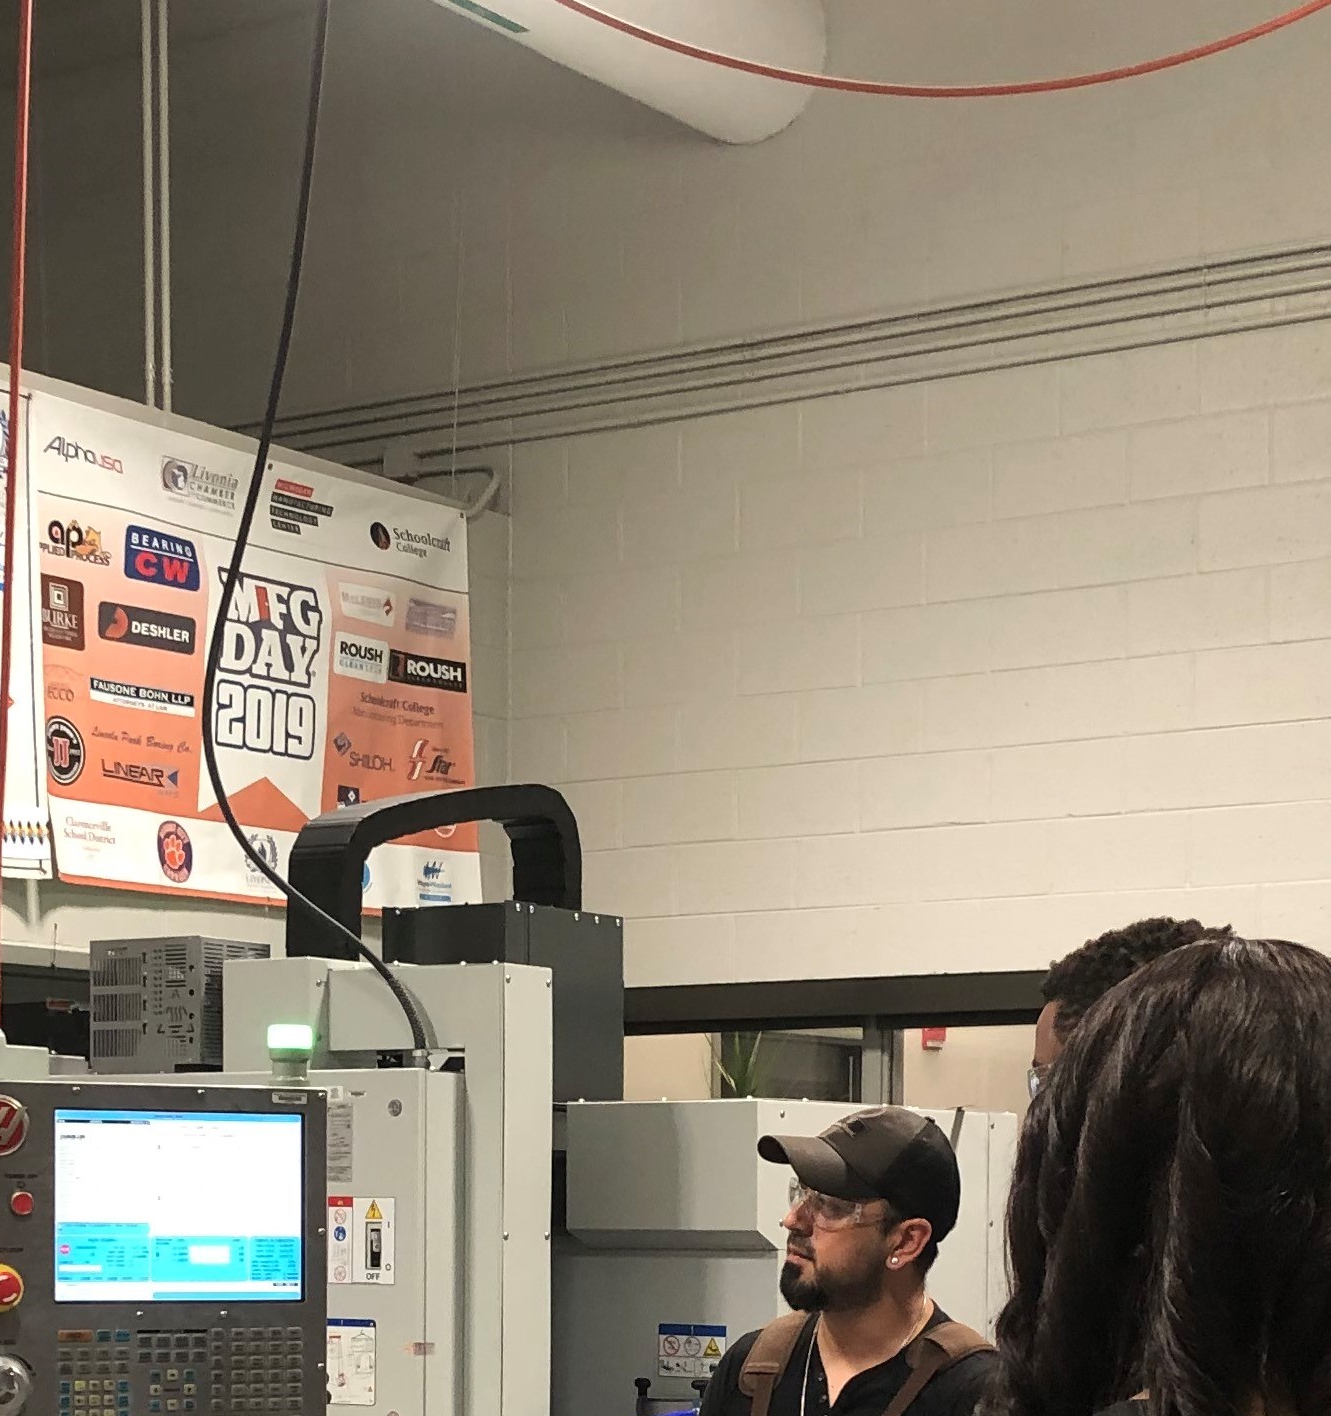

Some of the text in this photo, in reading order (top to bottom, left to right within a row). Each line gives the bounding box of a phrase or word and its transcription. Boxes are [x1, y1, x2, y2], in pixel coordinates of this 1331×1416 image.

[191, 463, 239, 490] Livonia
[189, 482, 236, 500] CHAMBER
[131, 531, 193, 558] BEARING
[393, 528, 451, 553] Schoolcraft
[396, 542, 428, 559] College
[218, 569, 320, 639] MFG
[131, 620, 190, 644] DESHLER
[218, 621, 319, 684] DAY
[339, 640, 384, 664] ROUSH
[407, 659, 463, 682] ROUSH
[92, 679, 136, 696] FAUSONE
[171, 693, 192, 705] LLP
[218, 680, 315, 760] 2019
[402, 699, 436, 716] College
[100, 758, 165, 788] LINEAR
[365, 1271, 381, 1282] OFF
